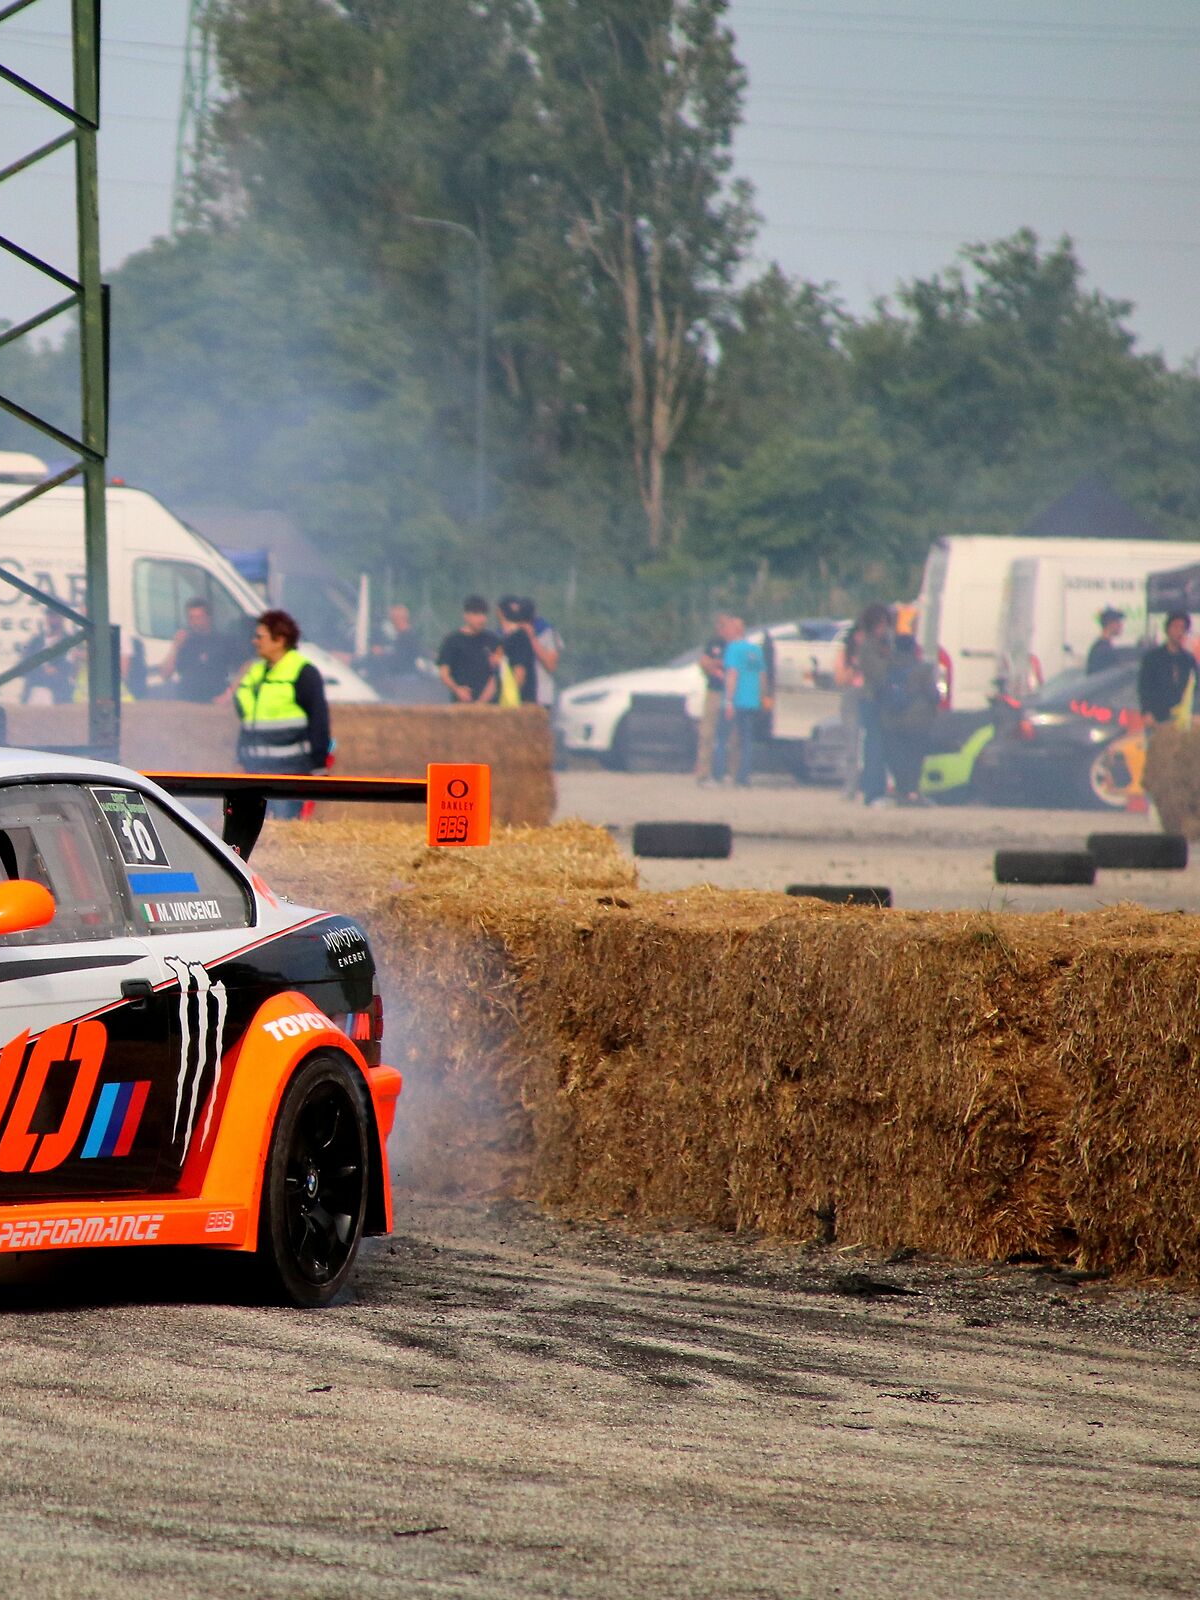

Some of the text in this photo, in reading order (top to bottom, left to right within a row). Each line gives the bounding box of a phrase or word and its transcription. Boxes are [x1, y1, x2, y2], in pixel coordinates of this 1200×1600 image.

[440, 801, 474, 811] OAKLEY
[121, 819, 156, 861] 10
[436, 815, 468, 842] BBS
[156, 900, 222, 922] M. VINCENZI
[322, 926, 366, 953] MONSTER
[337, 950, 367, 968] ENERGY
